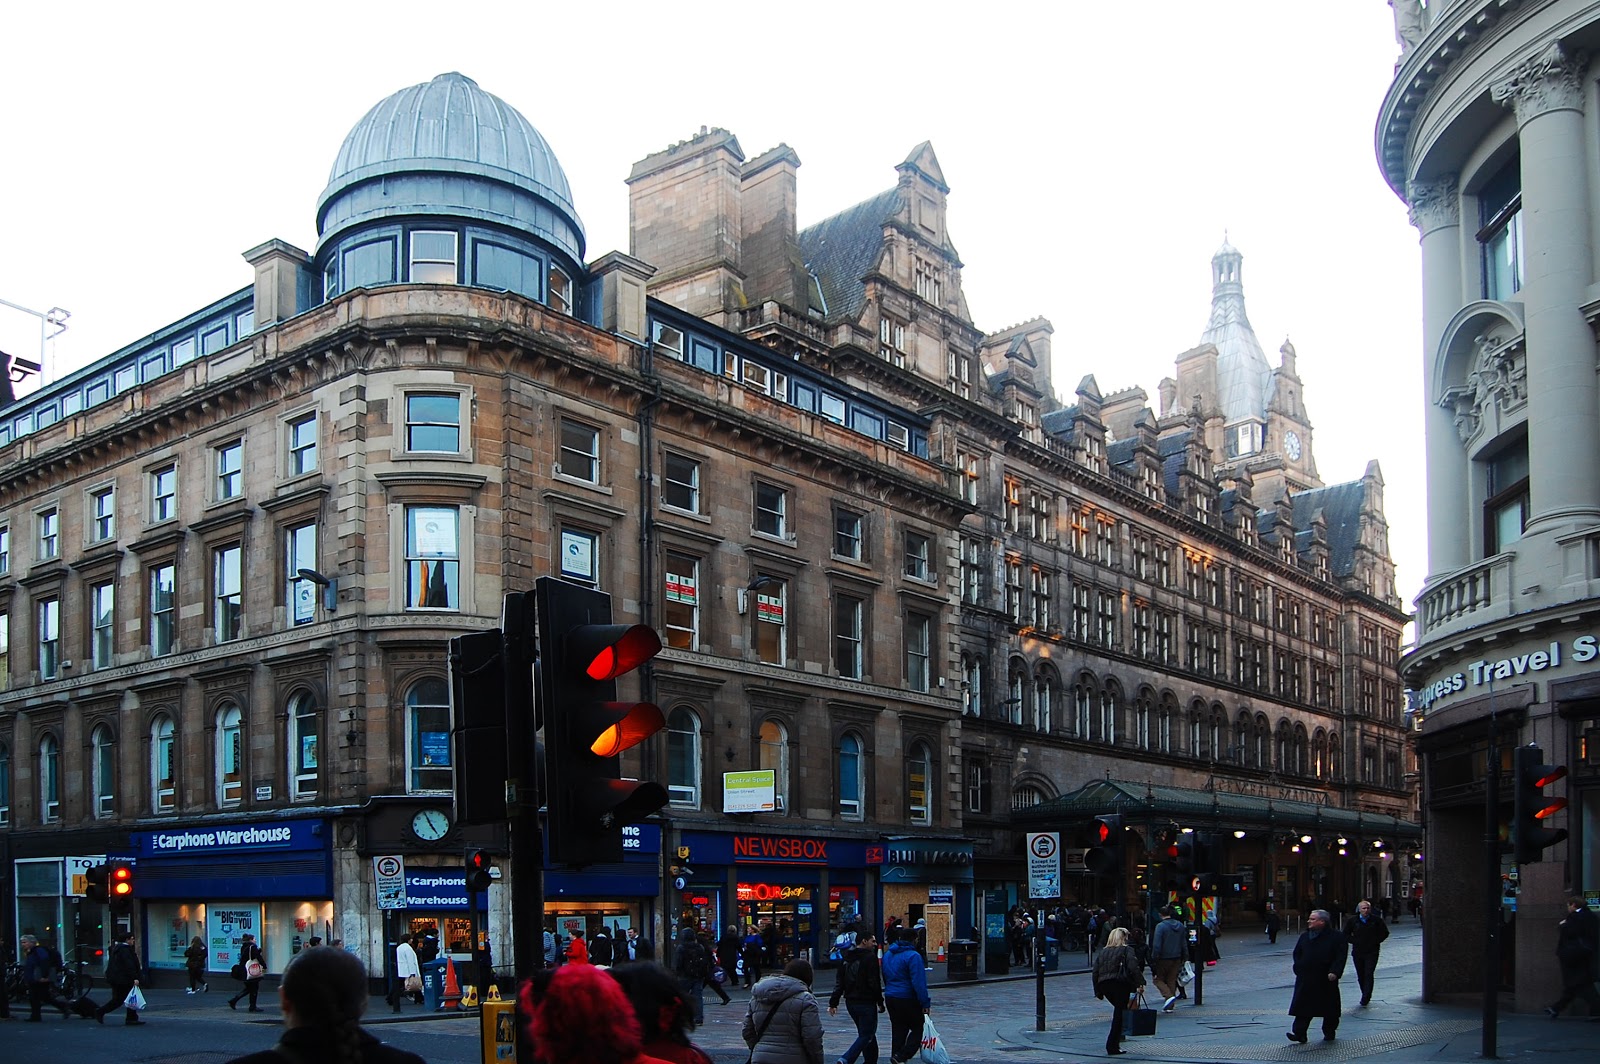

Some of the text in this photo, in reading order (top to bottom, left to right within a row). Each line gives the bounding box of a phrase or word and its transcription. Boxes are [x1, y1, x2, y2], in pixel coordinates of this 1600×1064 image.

[1469, 641, 1560, 686] Travel
[1572, 635, 1600, 664] S
[158, 831, 215, 850] Carphone
[216, 827, 291, 845] Warehouse
[734, 836, 828, 858] NEWSBOX
[72, 860, 92, 868] TO
[412, 877, 467, 887] Carphone
[751, 884, 783, 900] HOUR
[407, 896, 468, 905] Warehouse
[221, 911, 234, 924] BIG
[238, 917, 252, 930] YOU
